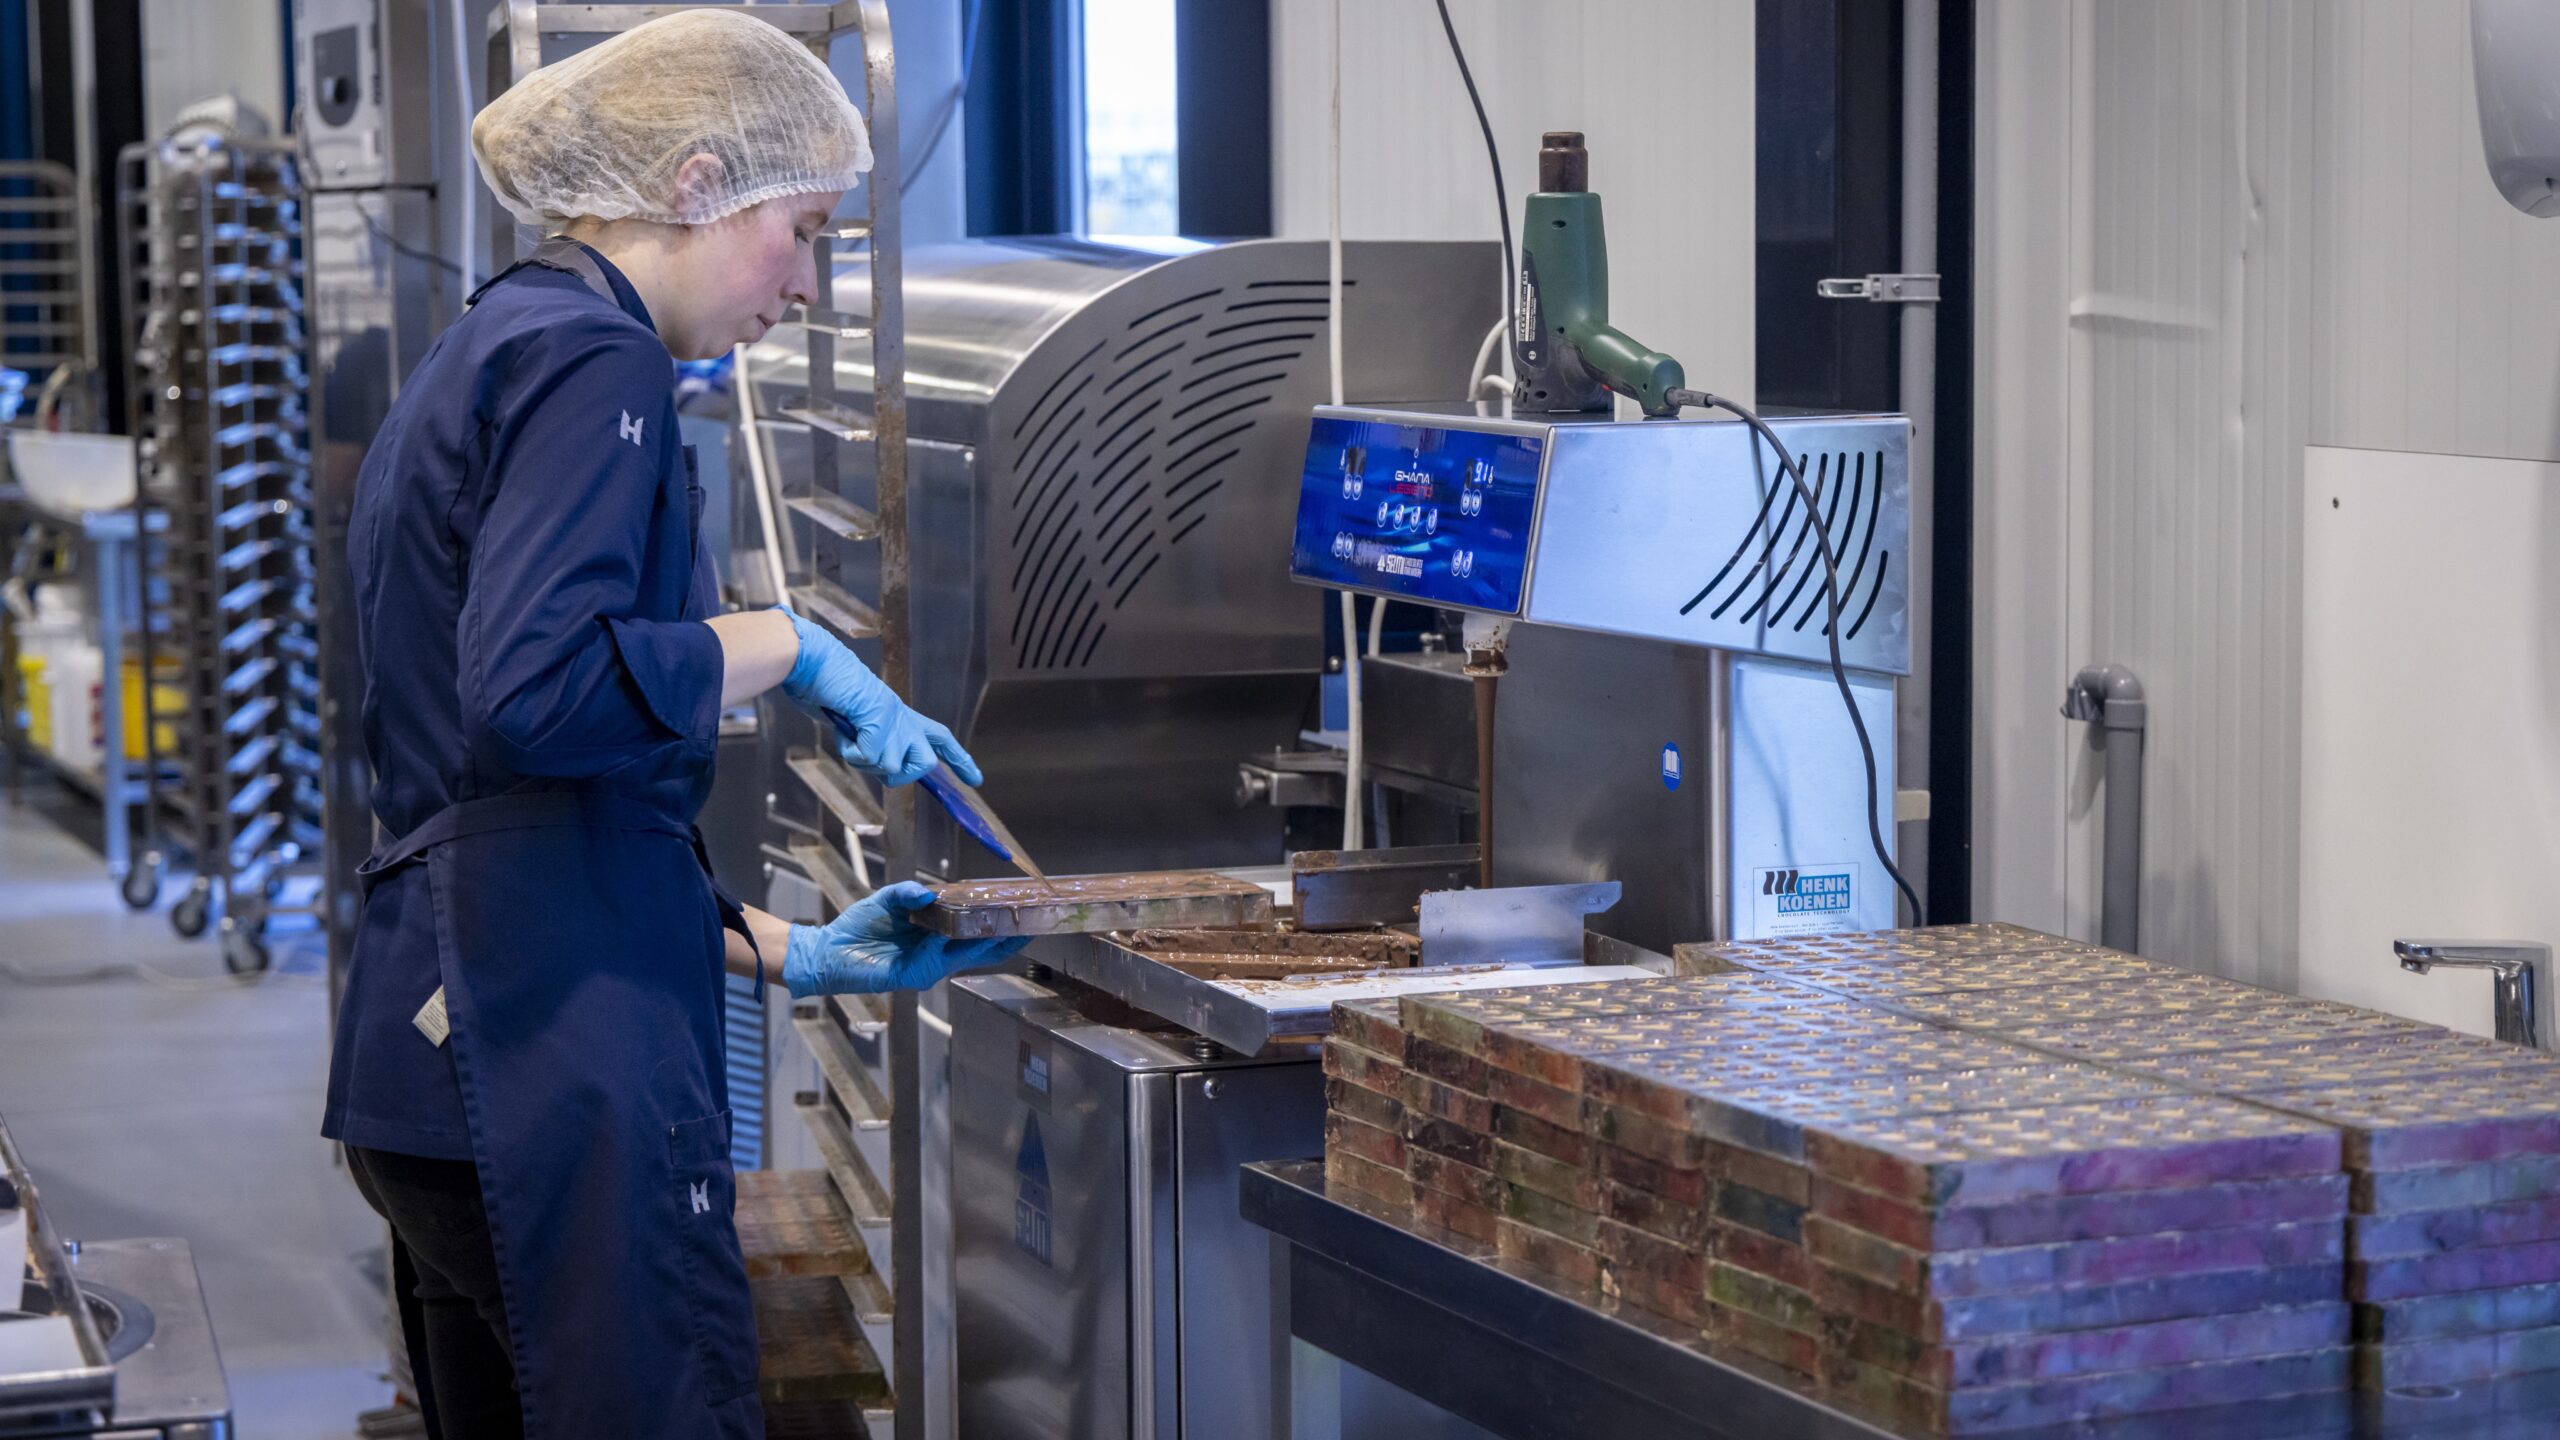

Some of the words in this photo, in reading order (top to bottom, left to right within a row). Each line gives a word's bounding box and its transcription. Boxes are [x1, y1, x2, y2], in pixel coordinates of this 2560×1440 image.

[1395, 470, 1430, 484] GHANA
[1802, 877, 1848, 892] HENK
[1779, 893, 1848, 911] KOENEN
